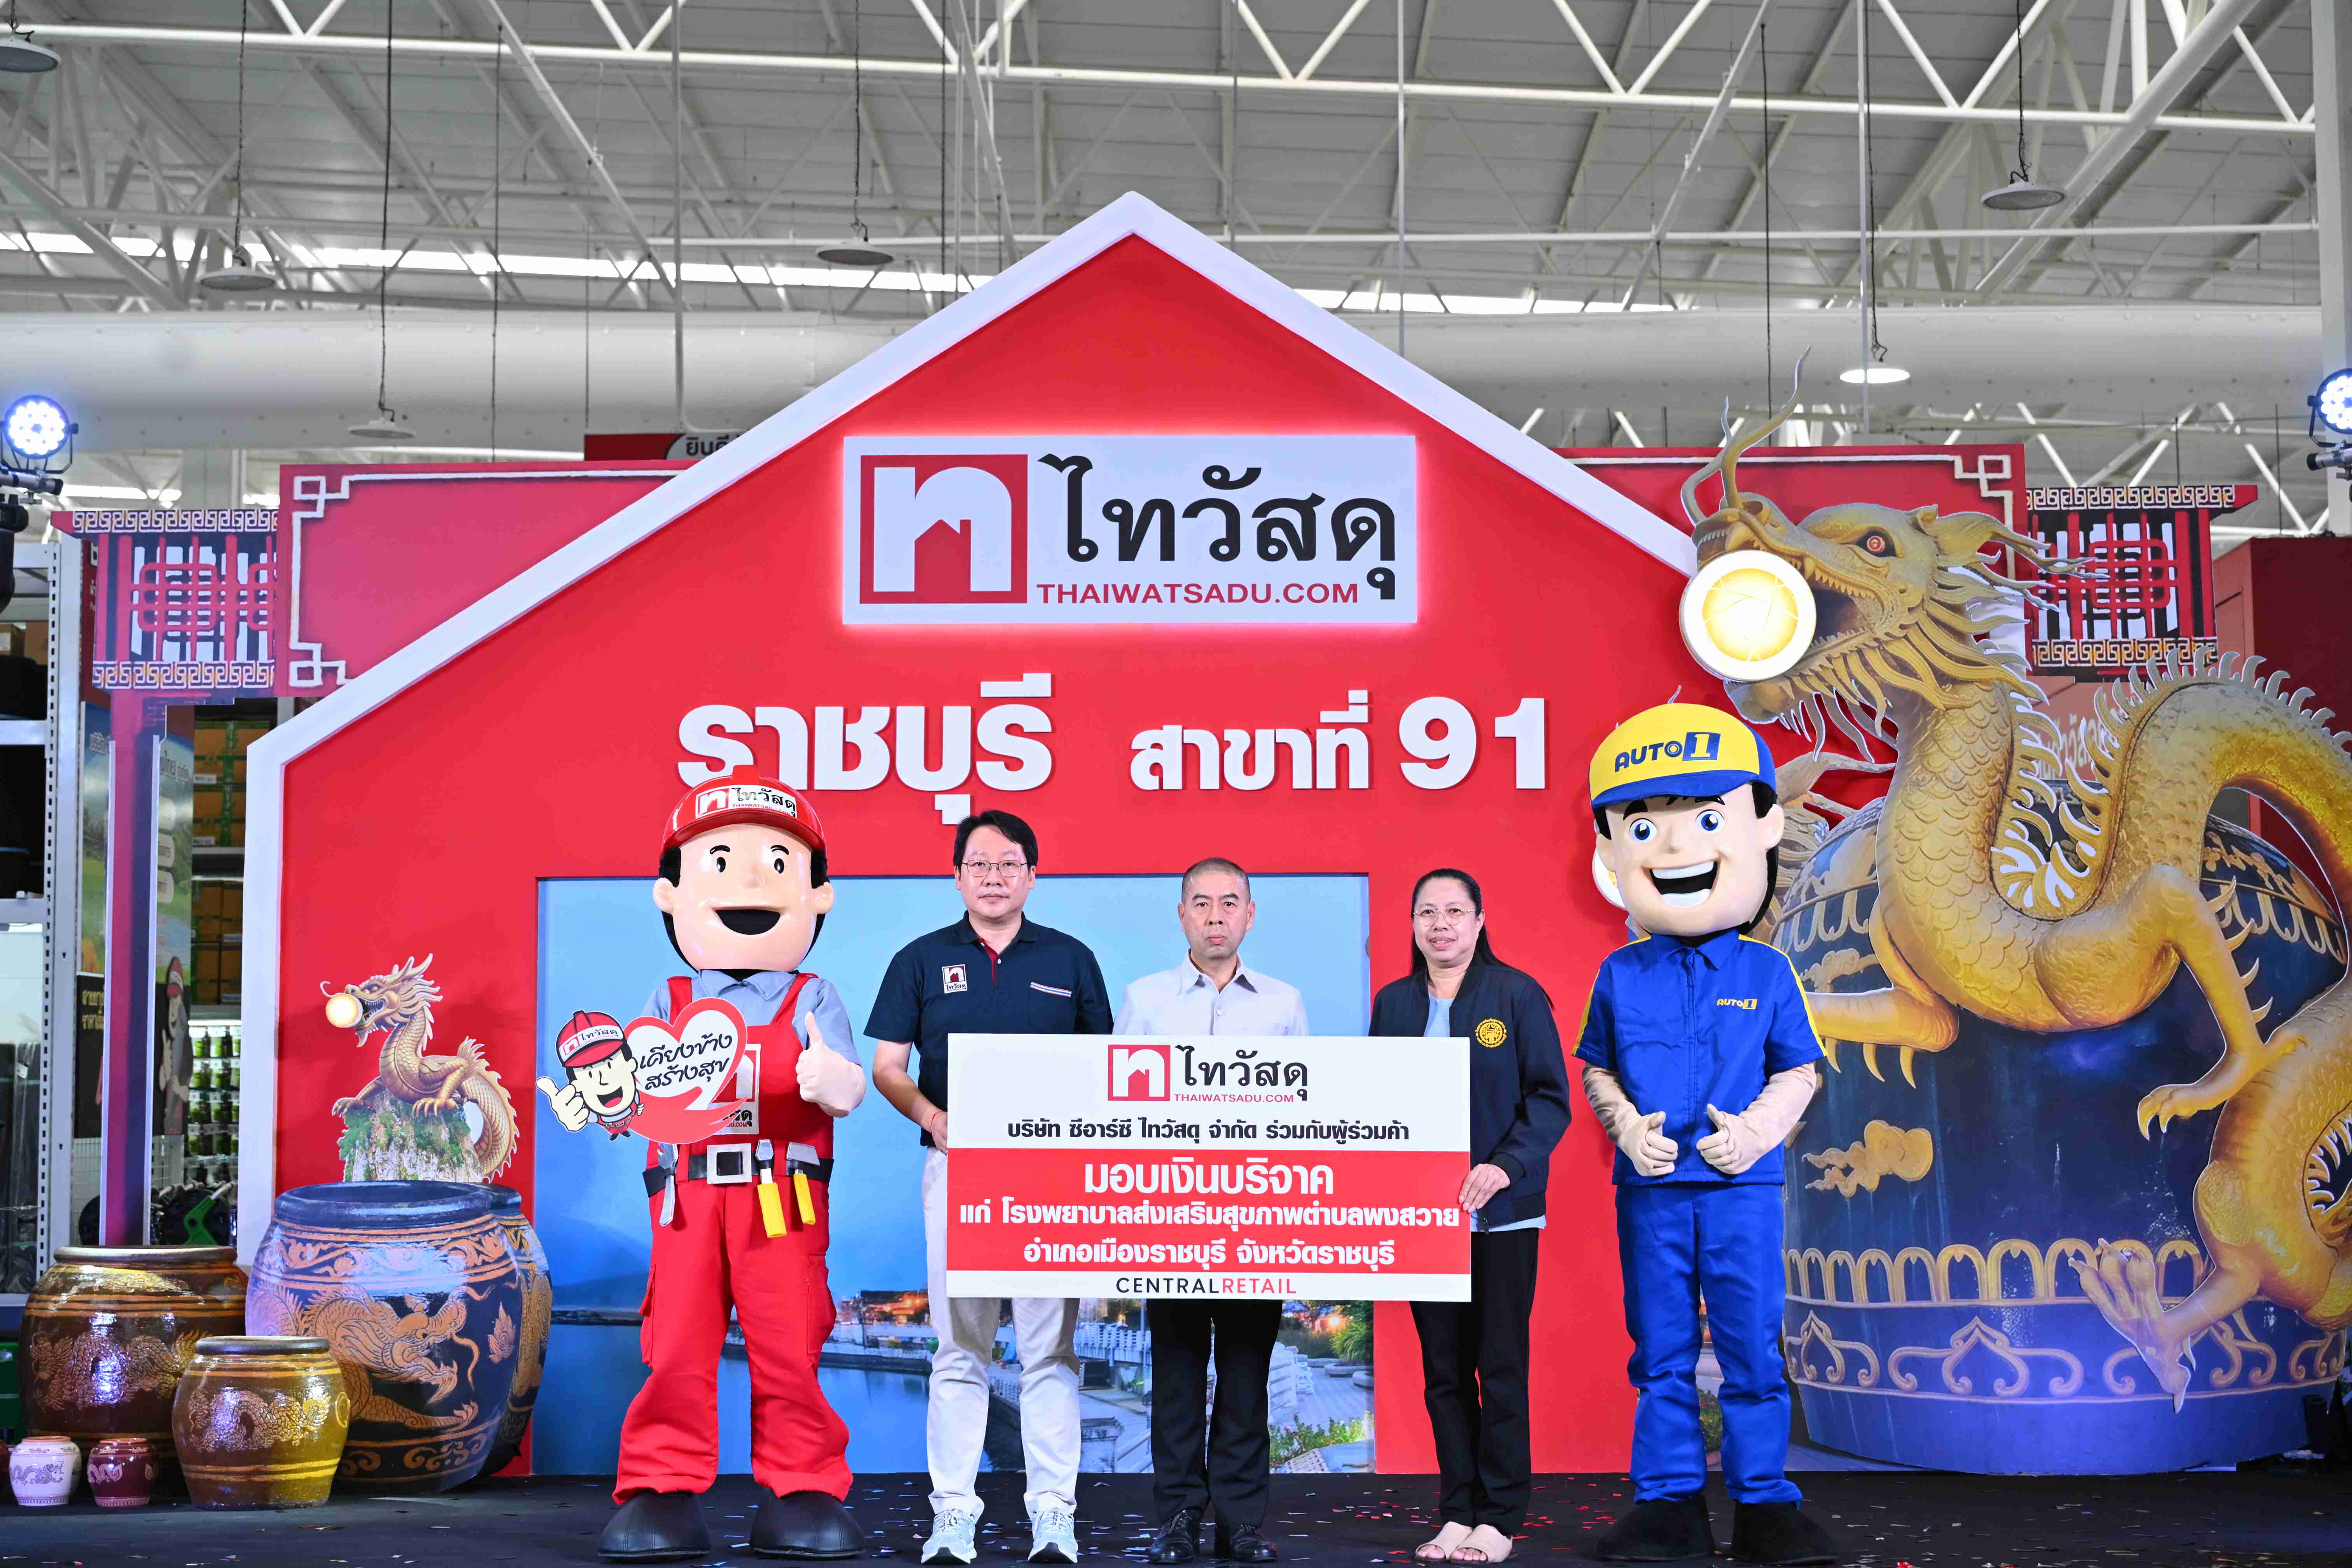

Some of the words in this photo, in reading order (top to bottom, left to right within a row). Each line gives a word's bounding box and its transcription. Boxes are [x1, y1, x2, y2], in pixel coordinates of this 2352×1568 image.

[1037, 453, 1395, 600] ไทวัสดุ
[1037, 583, 1358, 604] THAIWATSADU.COM
[678, 673, 1052, 824] ราชบุรี
[1130, 690, 1369, 790] สาขาที่
[1398, 696, 1545, 790] 91
[731, 788, 796, 817] ไทวัสดุ
[640, 1033, 733, 1069] เคียงข้าง
[645, 1057, 730, 1090] สร้างสุข
[1174, 1045, 1308, 1101] ไทวัสดุ
[1174, 1094, 1294, 1102] THAIWATSADU.COM
[1008, 1118, 1060, 1138] บริษัท
[1069, 1118, 1132, 1138] ซีอาร์ซี
[1138, 1117, 1200, 1144] ไทวัสดุ
[1209, 1119, 1257, 1139] จำกัด
[1266, 1120, 1409, 1144] ร่วมกับผู้ร่วมค้า
[1085, 1157, 1334, 1194] มอบเงินบริจาค
[960, 1199, 991, 1223] แก่
[1002, 1196, 1459, 1232] โรงพยาบาลส่งเสริมสุขภาพตำบลพงสวาย
[1024, 1237, 1226, 1270] อำเภอเมืองราชบุรี
[1237, 1238, 1395, 1271] จังหวัดราชบุรี
